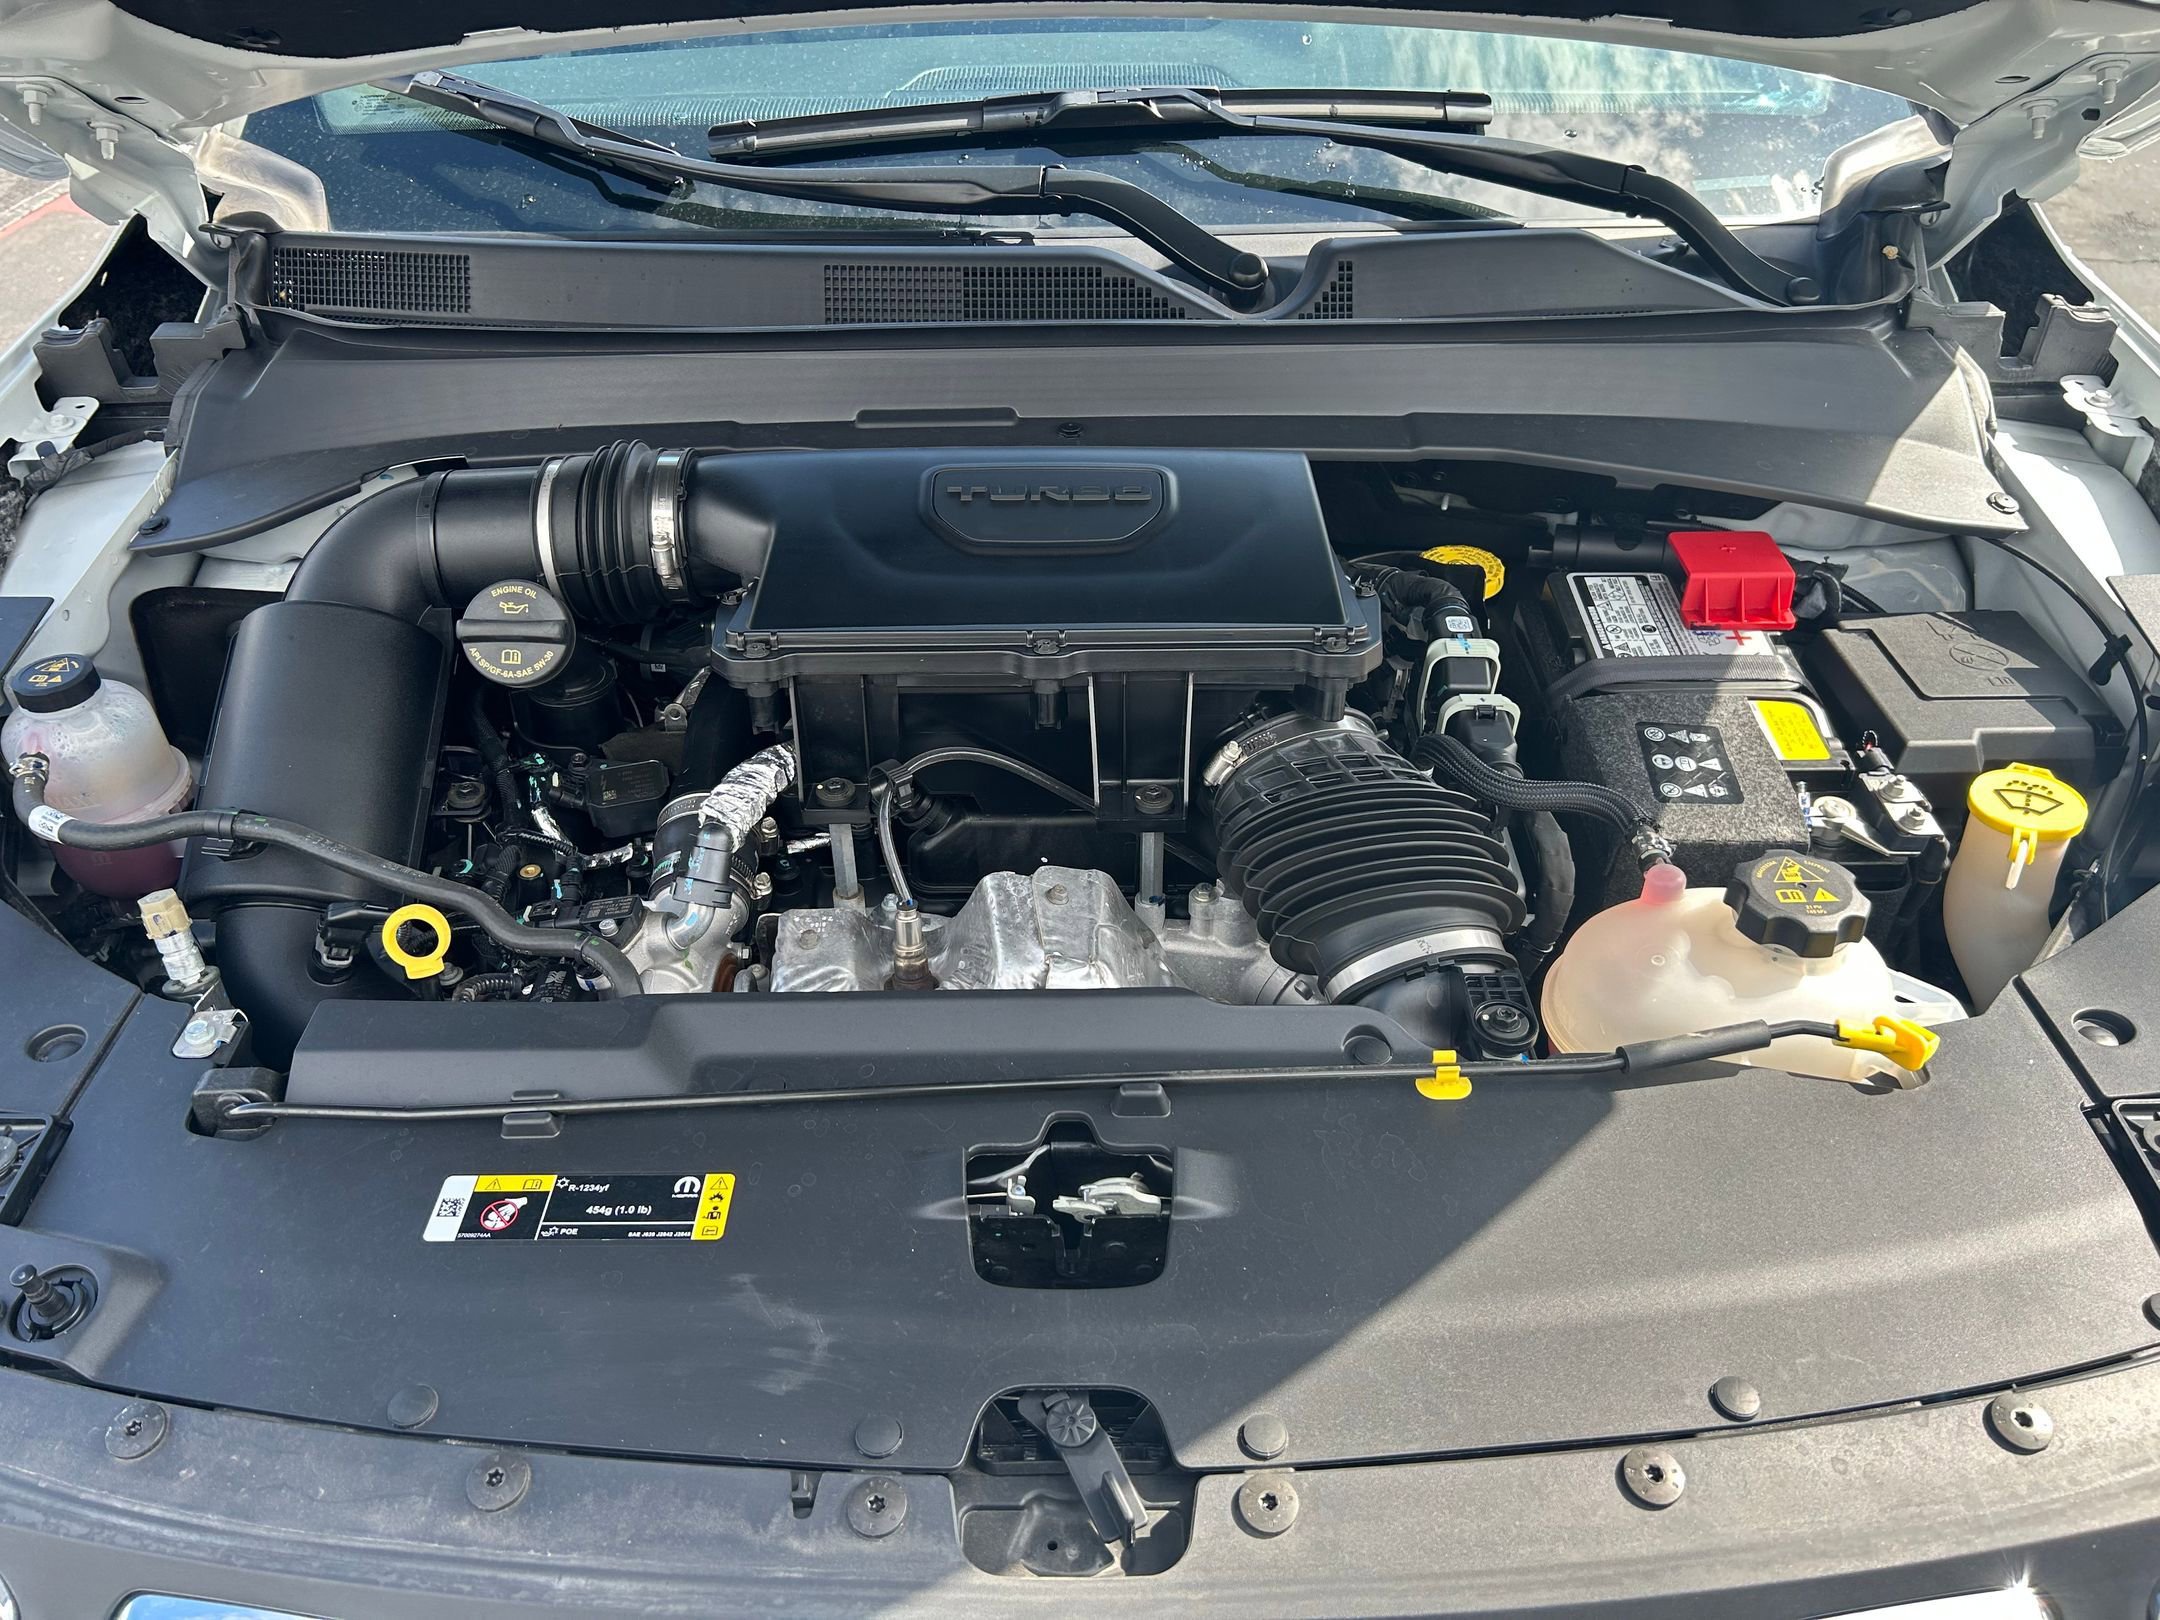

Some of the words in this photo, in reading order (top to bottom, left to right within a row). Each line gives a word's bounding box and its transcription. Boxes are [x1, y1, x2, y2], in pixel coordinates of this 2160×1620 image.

[947, 485, 1152, 502] TURBO
[491, 586, 523, 597] ENGINE
[525, 588, 537, 599] OIL
[469, 647, 480, 661] API
[534, 650, 554, 671] 5W-30
[568, 1183, 610, 1193] R-1234yf
[585, 1205, 613, 1216] 454g
[614, 1205, 636, 1216] (1.0
[637, 1205, 652, 1216] lb)
